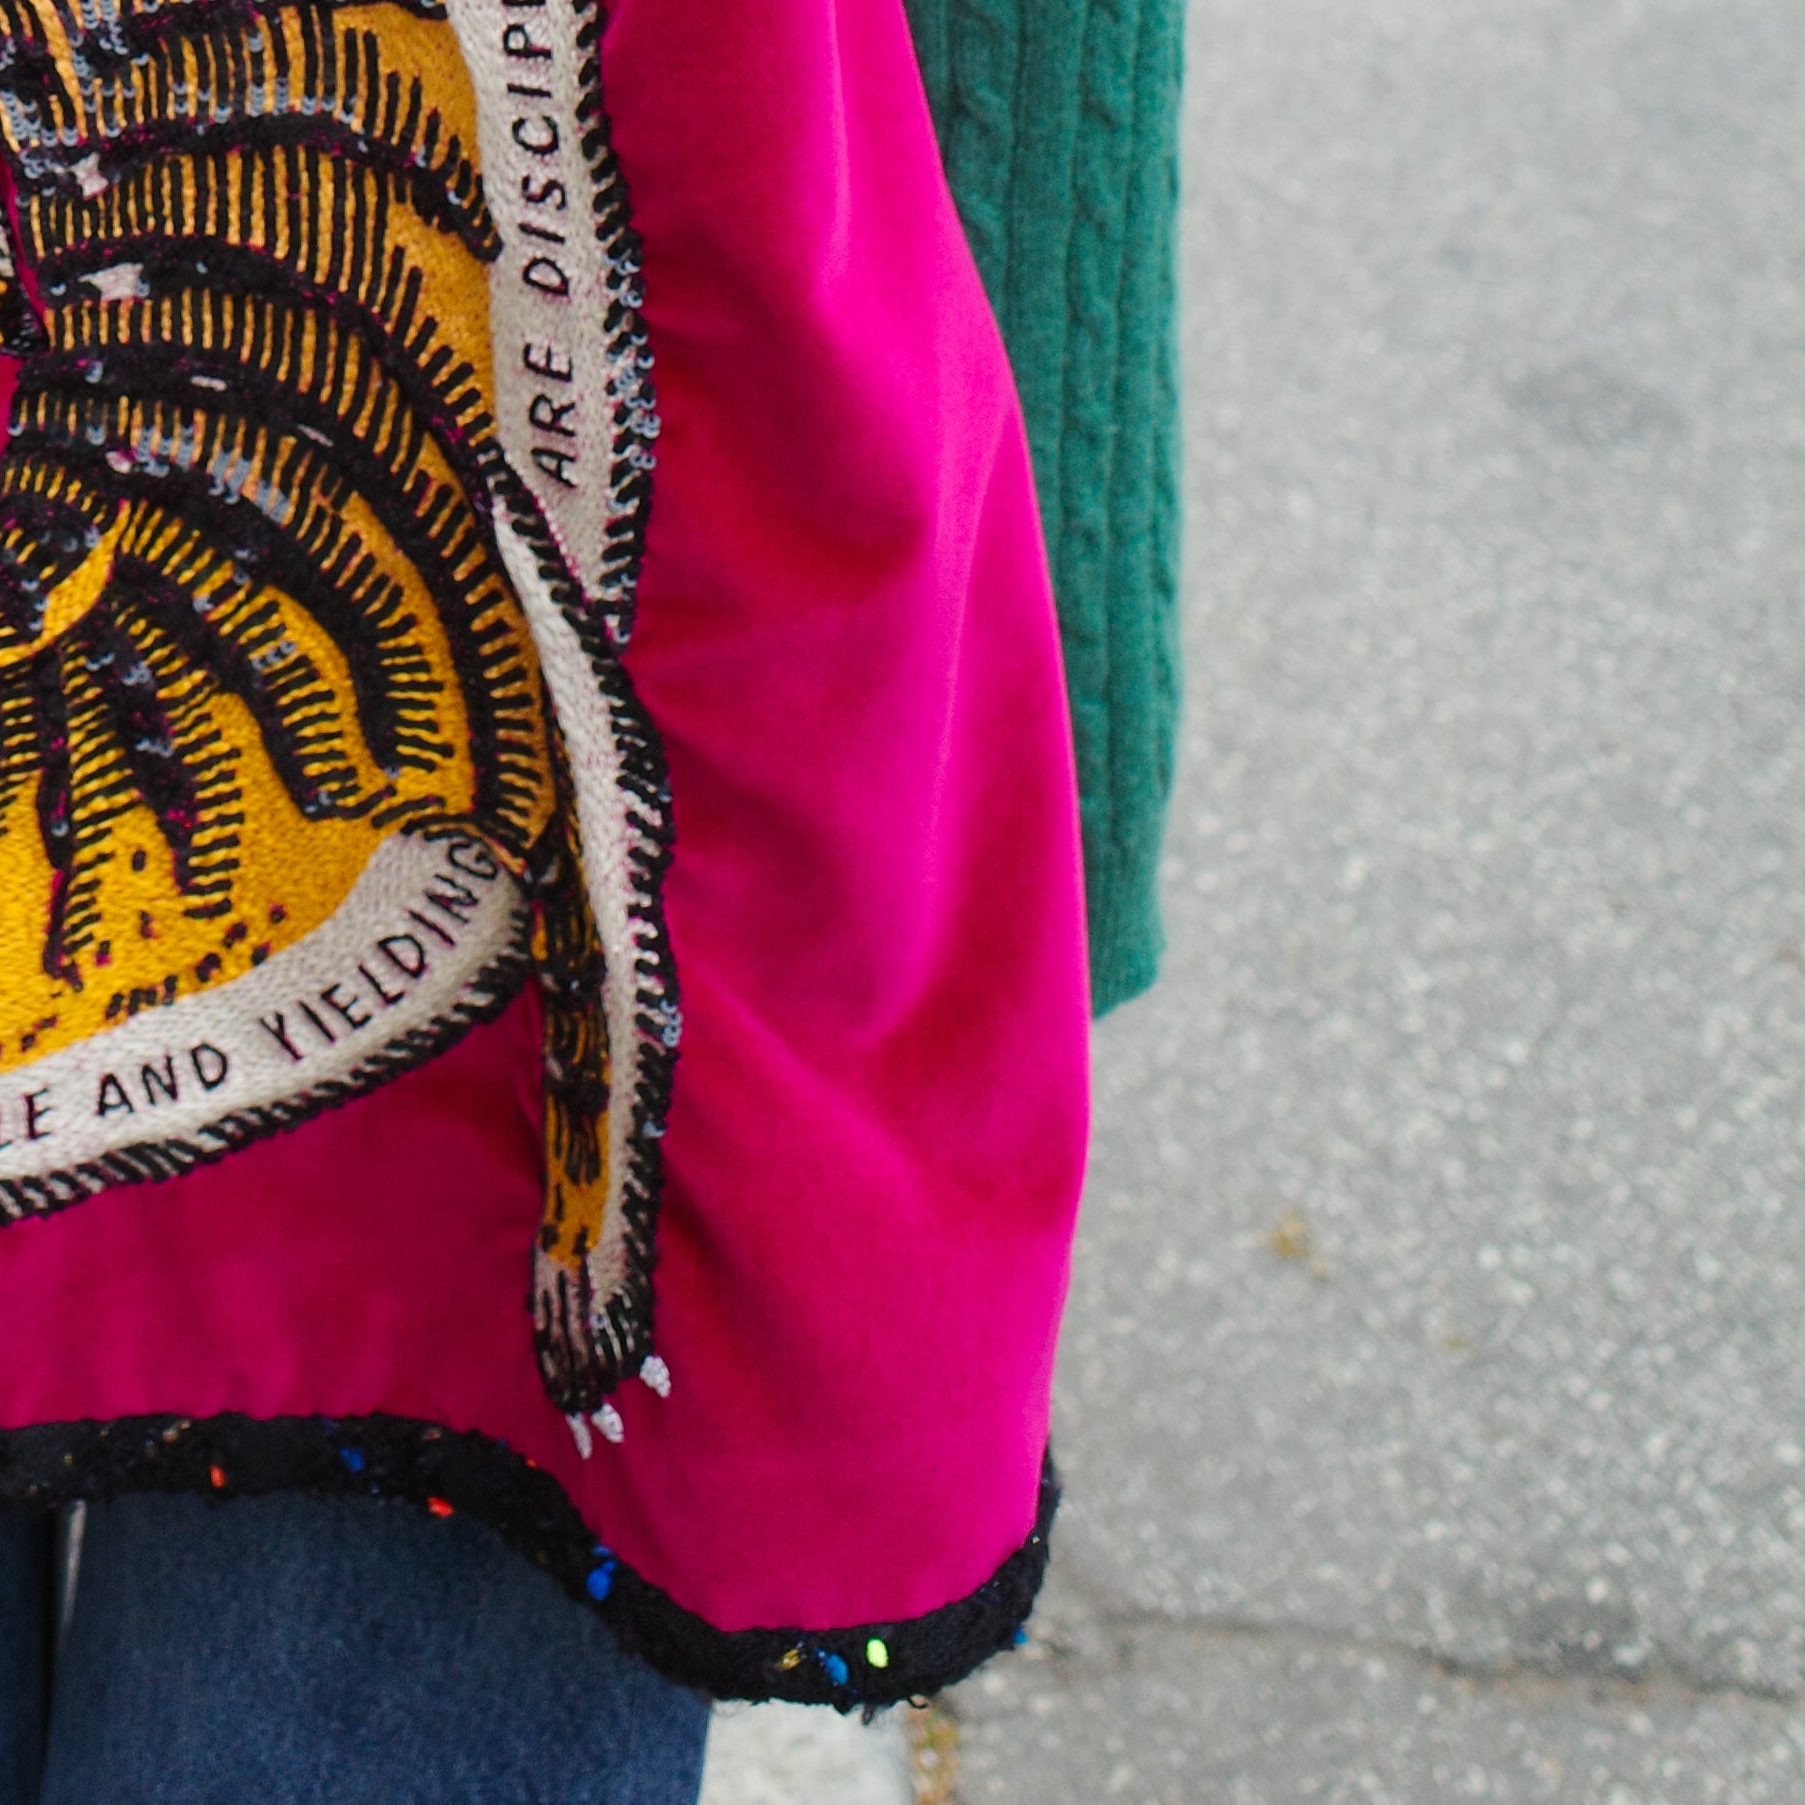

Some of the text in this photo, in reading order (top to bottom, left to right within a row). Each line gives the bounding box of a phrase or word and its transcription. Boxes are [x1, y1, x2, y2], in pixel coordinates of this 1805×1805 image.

[523, 343, 575, 488] ARE
[95, 1042, 230, 1119] AND
[258, 839, 499, 1061] YIELDING
